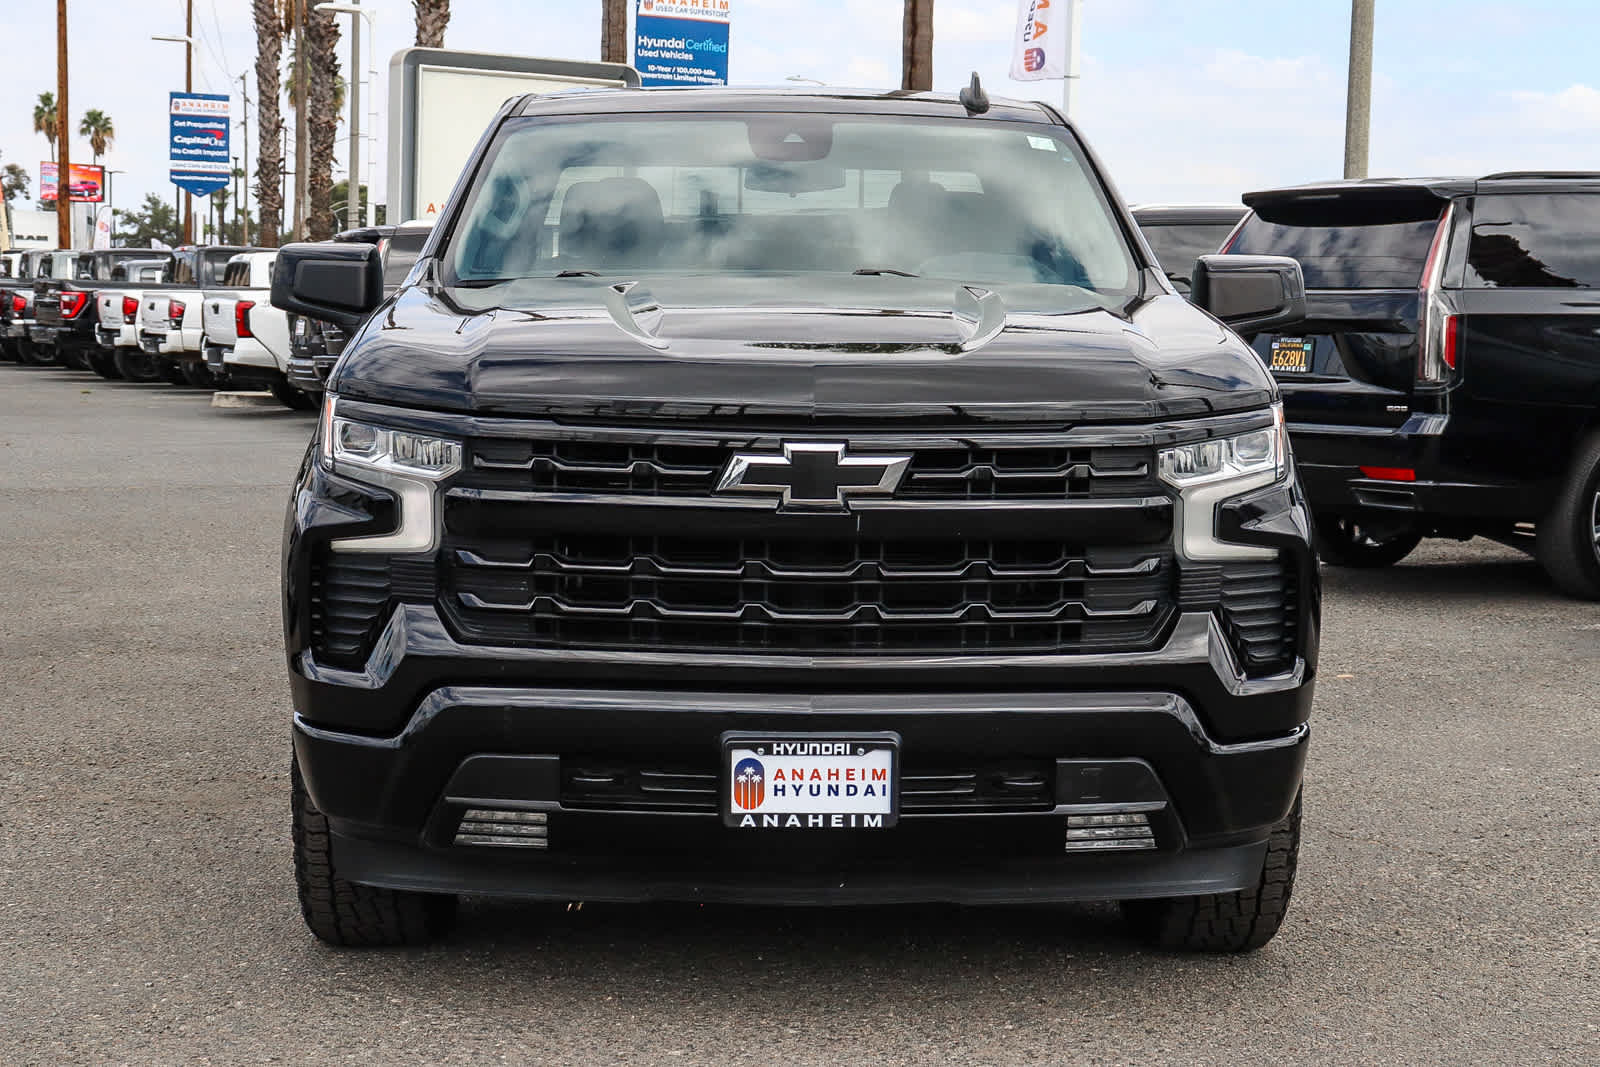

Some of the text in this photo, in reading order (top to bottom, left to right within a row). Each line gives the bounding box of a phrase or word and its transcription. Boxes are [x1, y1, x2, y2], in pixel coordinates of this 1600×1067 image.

[689, 9, 729, 17] SUPERSTORE
[638, 36, 726, 53] Hyundai Certified
[638, 49, 693, 60] Used Vehicles
[1272, 350, 1306, 366] E628V1
[773, 743, 850, 755] HYUNDAI
[773, 768, 887, 781] ANAHEIM
[773, 784, 887, 797] HYUNDAI
[739, 814, 883, 828] ANAHEIM
